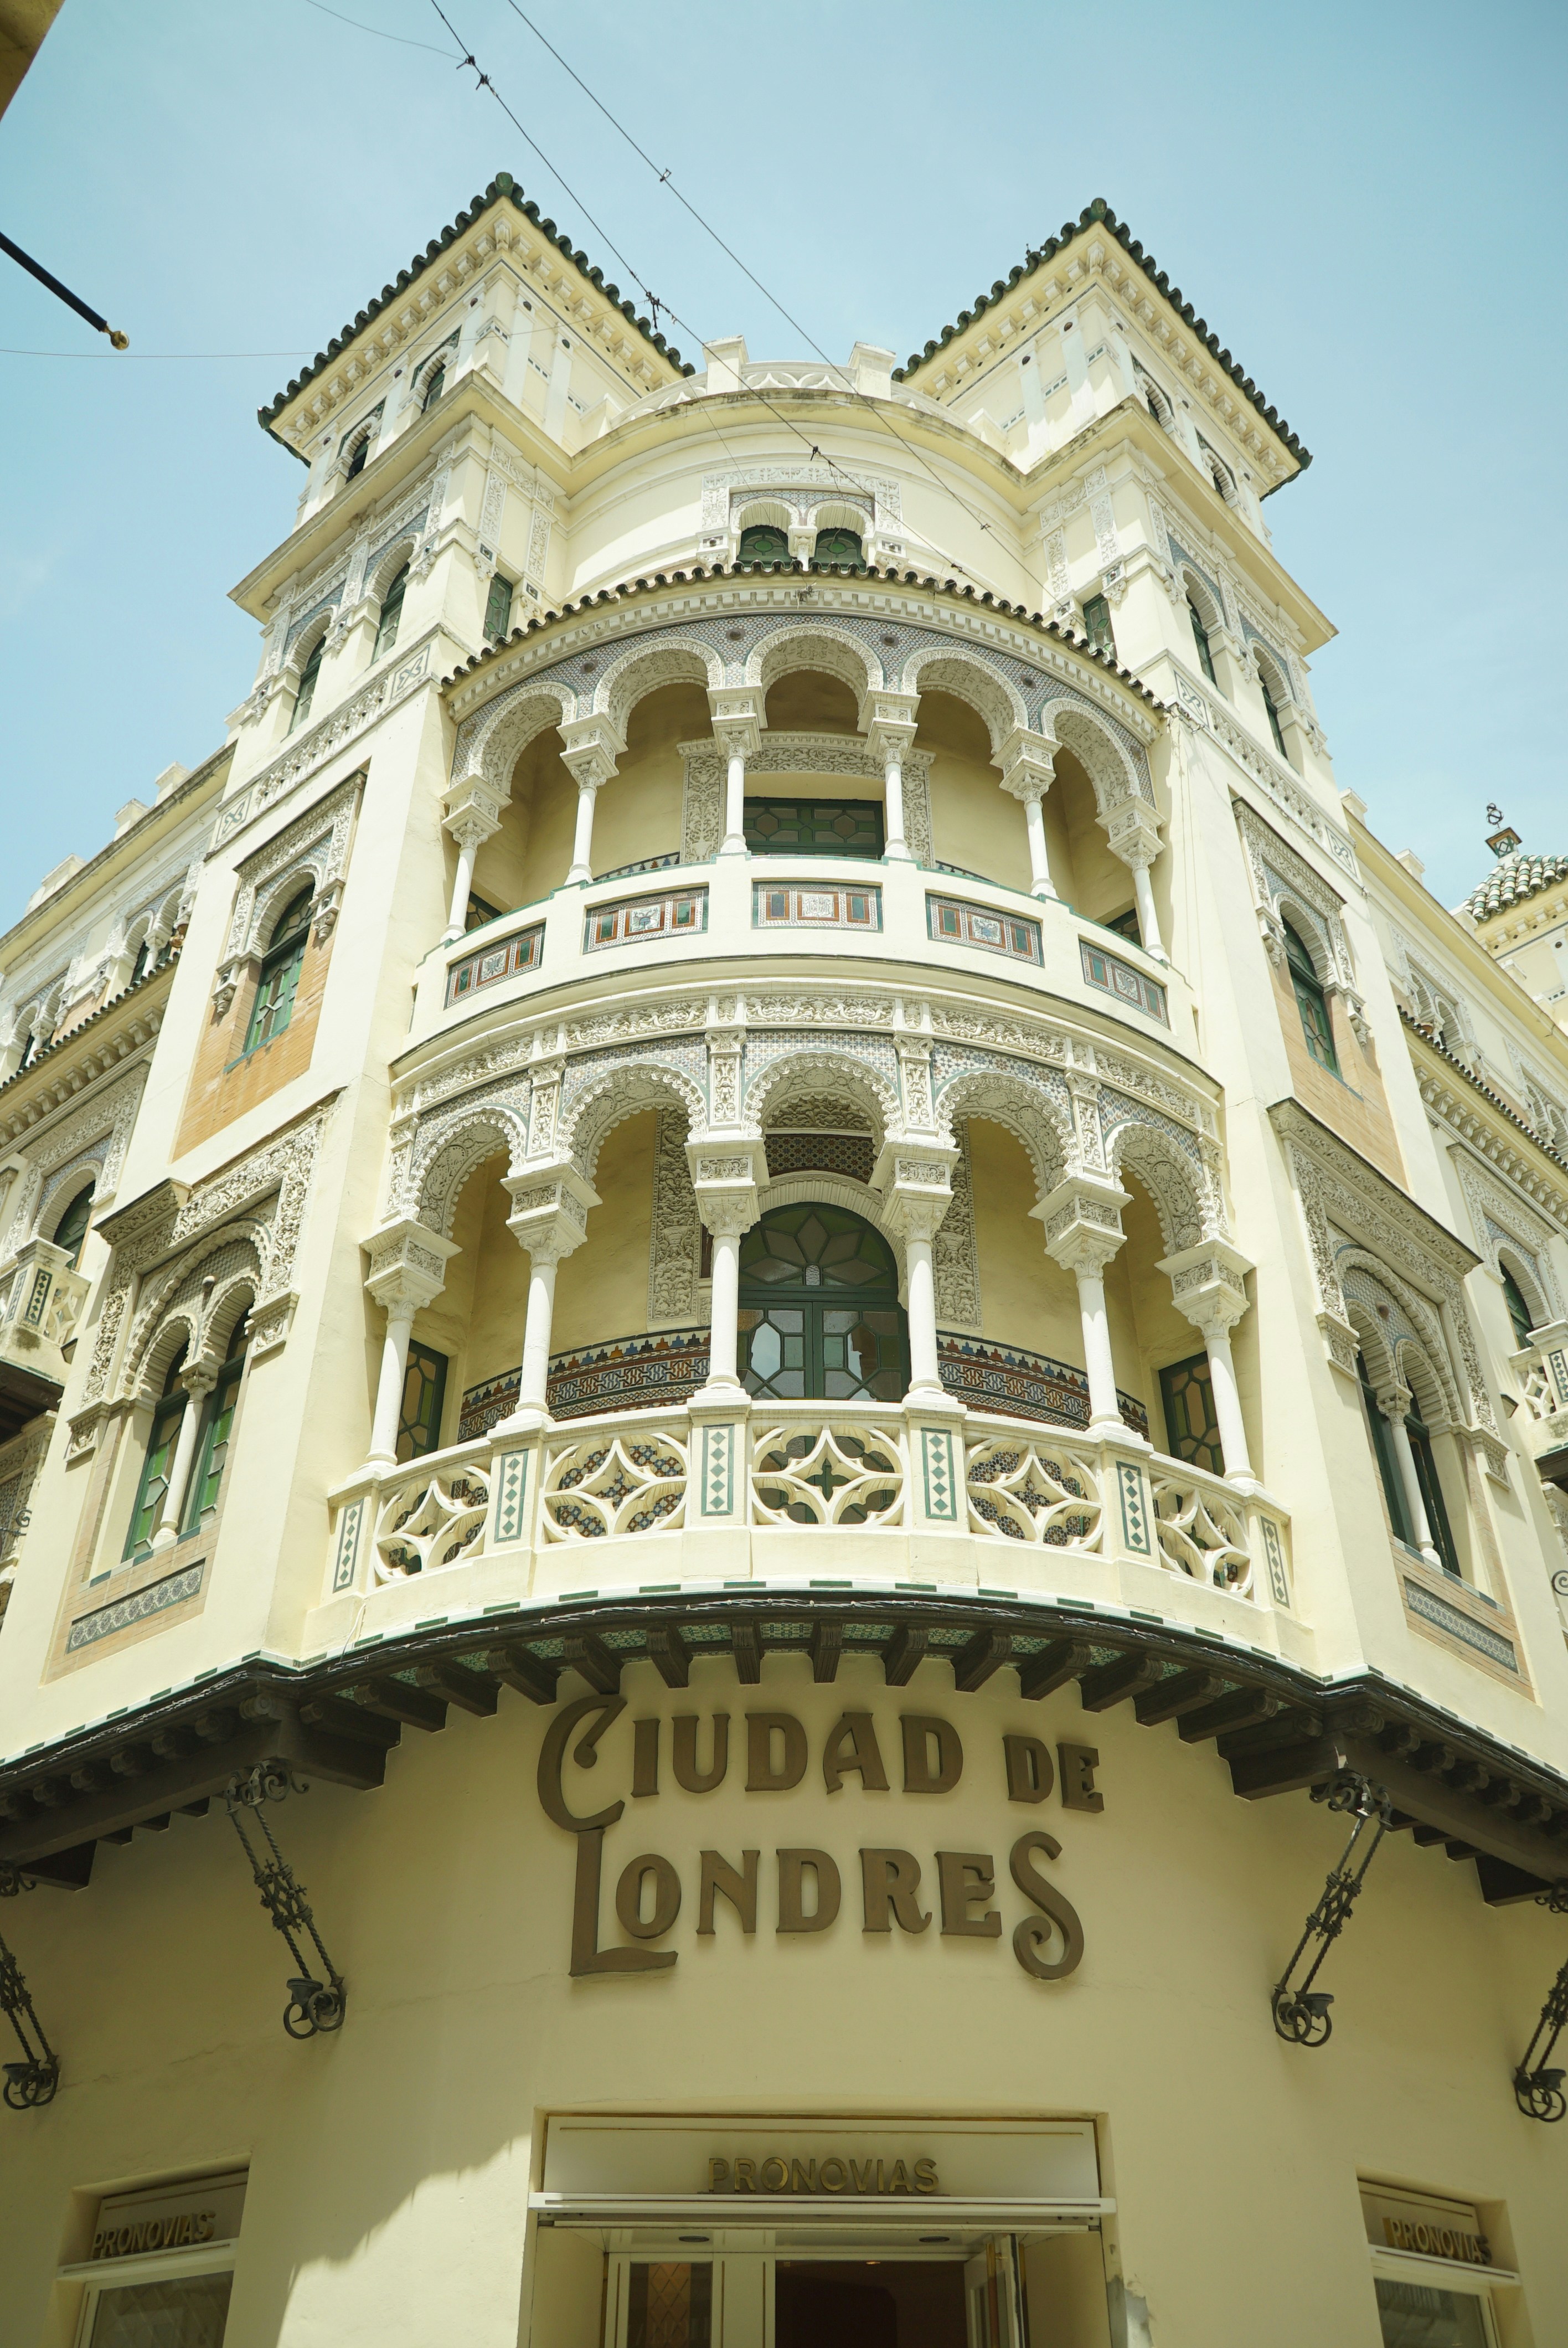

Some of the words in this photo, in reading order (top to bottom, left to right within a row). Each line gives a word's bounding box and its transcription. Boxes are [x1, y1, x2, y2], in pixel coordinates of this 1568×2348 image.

[537, 1695, 963, 1832] CIUDAD
[1003, 1734, 1105, 1813] DE
[569, 1829, 1085, 1980] LONDRES
[708, 2157, 940, 2192] PRONOVIAS
[92, 2210, 216, 2258] PRONOVIAS
